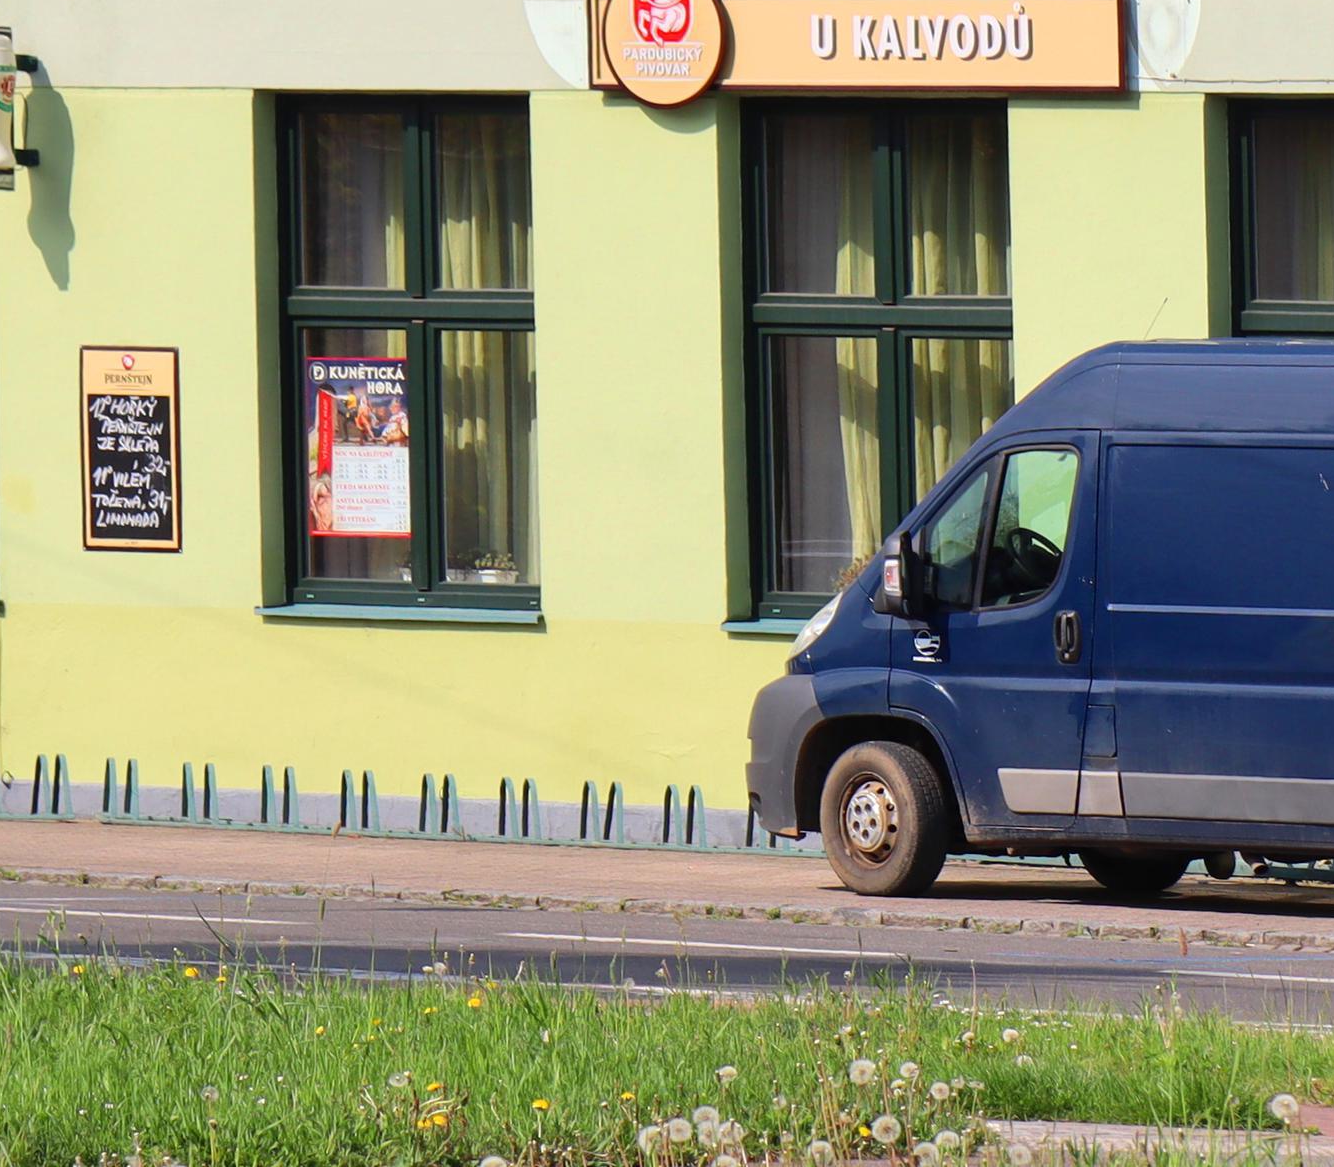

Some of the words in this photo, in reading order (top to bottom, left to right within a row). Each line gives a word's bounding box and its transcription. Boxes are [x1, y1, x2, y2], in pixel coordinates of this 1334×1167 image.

[810, 14, 836, 60] U
[852, 1, 1033, 61] KALVODŮ
[623, 46, 703, 62] PARDUBICKÝ
[635, 64, 691, 77] PIVOVAR
[104, 373, 153, 385] PERNŠTEJN
[329, 363, 405, 381] KUNĚTICKÁ
[367, 381, 404, 395] HORA
[110, 395, 158, 417] HOŘKÝ
